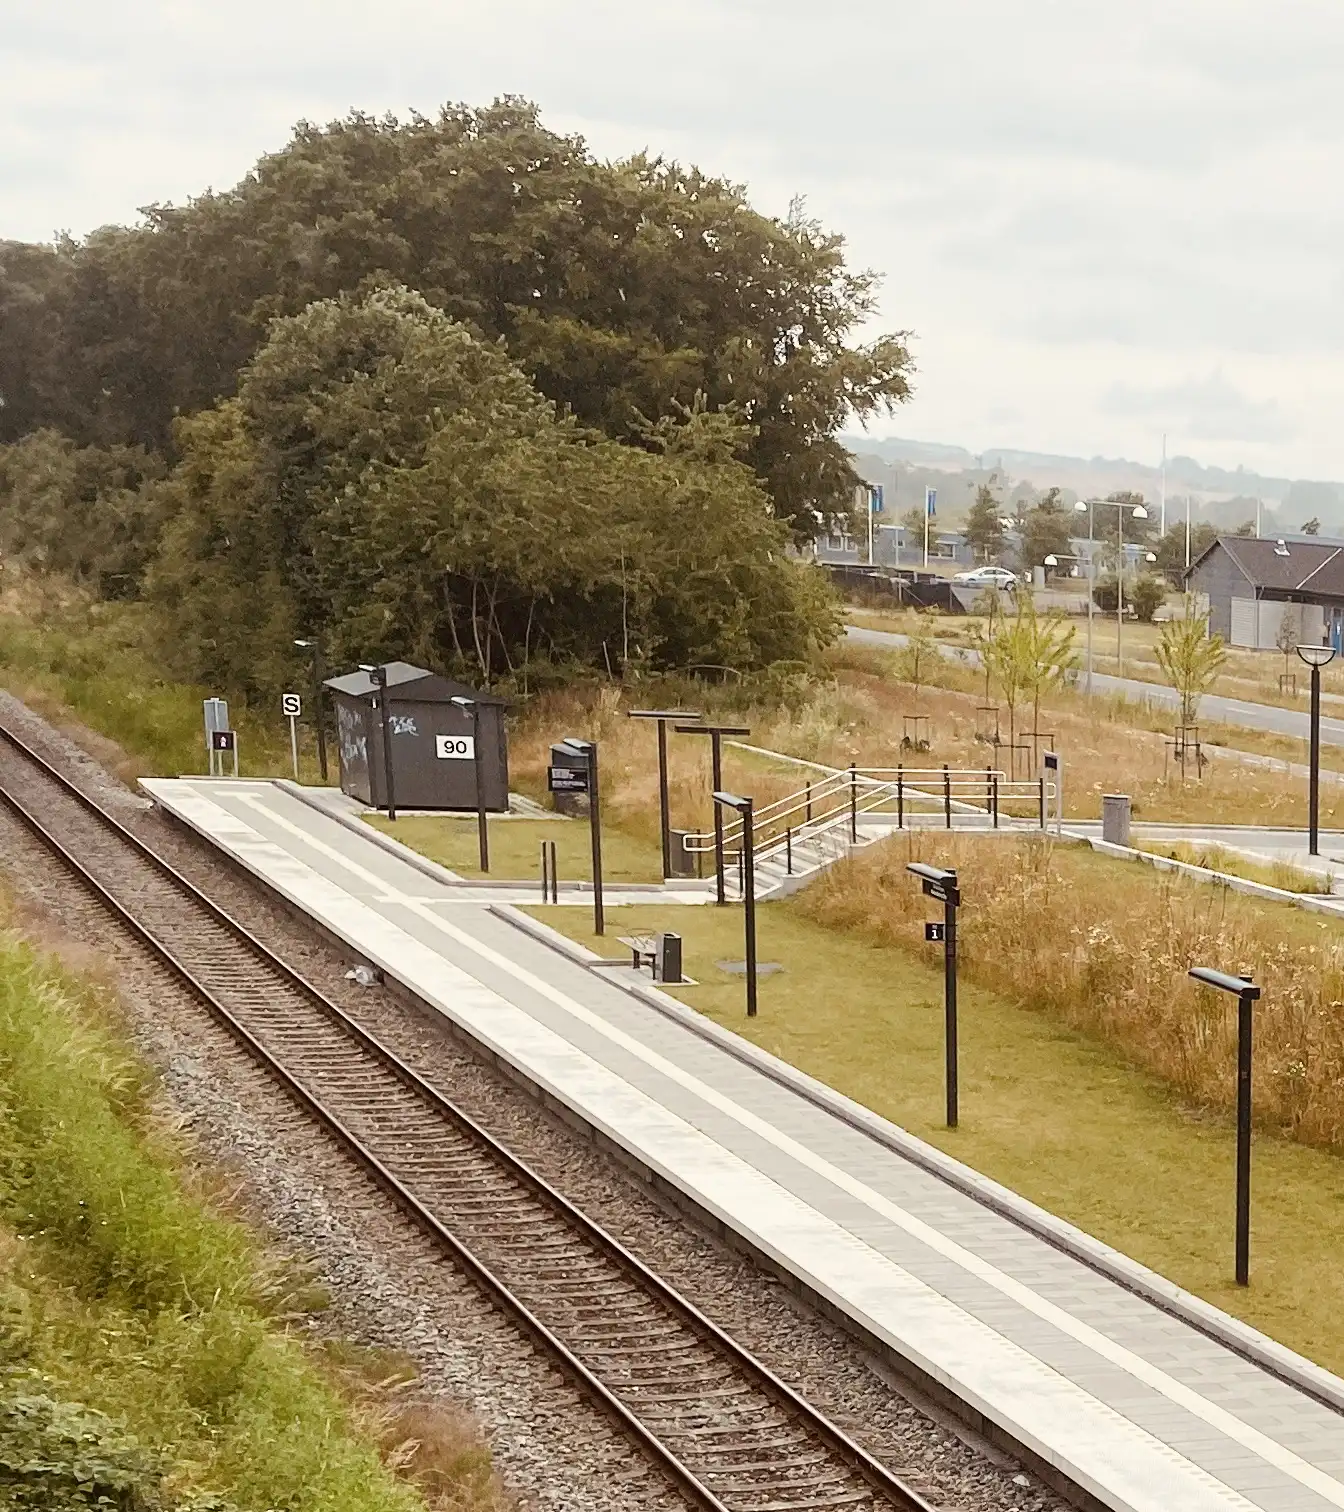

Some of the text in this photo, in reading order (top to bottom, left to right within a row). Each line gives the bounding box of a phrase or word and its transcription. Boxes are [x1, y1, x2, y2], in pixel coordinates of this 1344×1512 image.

[285, 697, 298, 712] S
[444, 740, 467, 754] 90
[931, 929, 938, 939] 1
